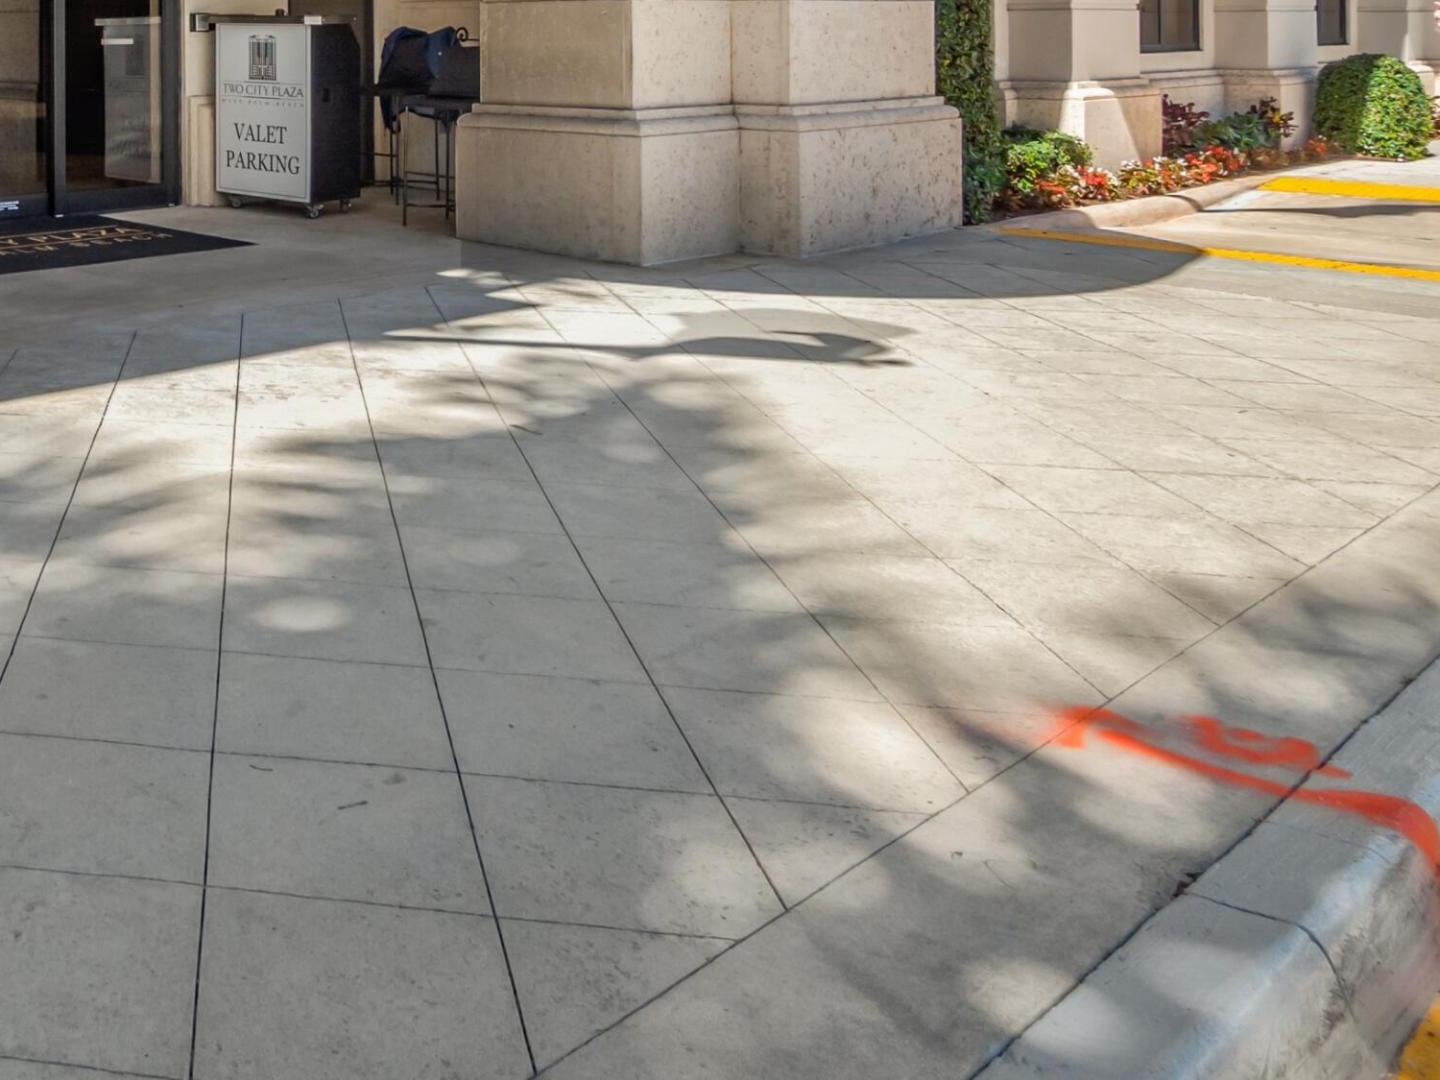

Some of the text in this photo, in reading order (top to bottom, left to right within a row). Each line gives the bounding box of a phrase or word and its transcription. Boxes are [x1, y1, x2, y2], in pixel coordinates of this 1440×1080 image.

[224, 83, 304, 97] TWO CITY PLAZA
[234, 123, 288, 145] VALET
[226, 150, 300, 175] PARKING
